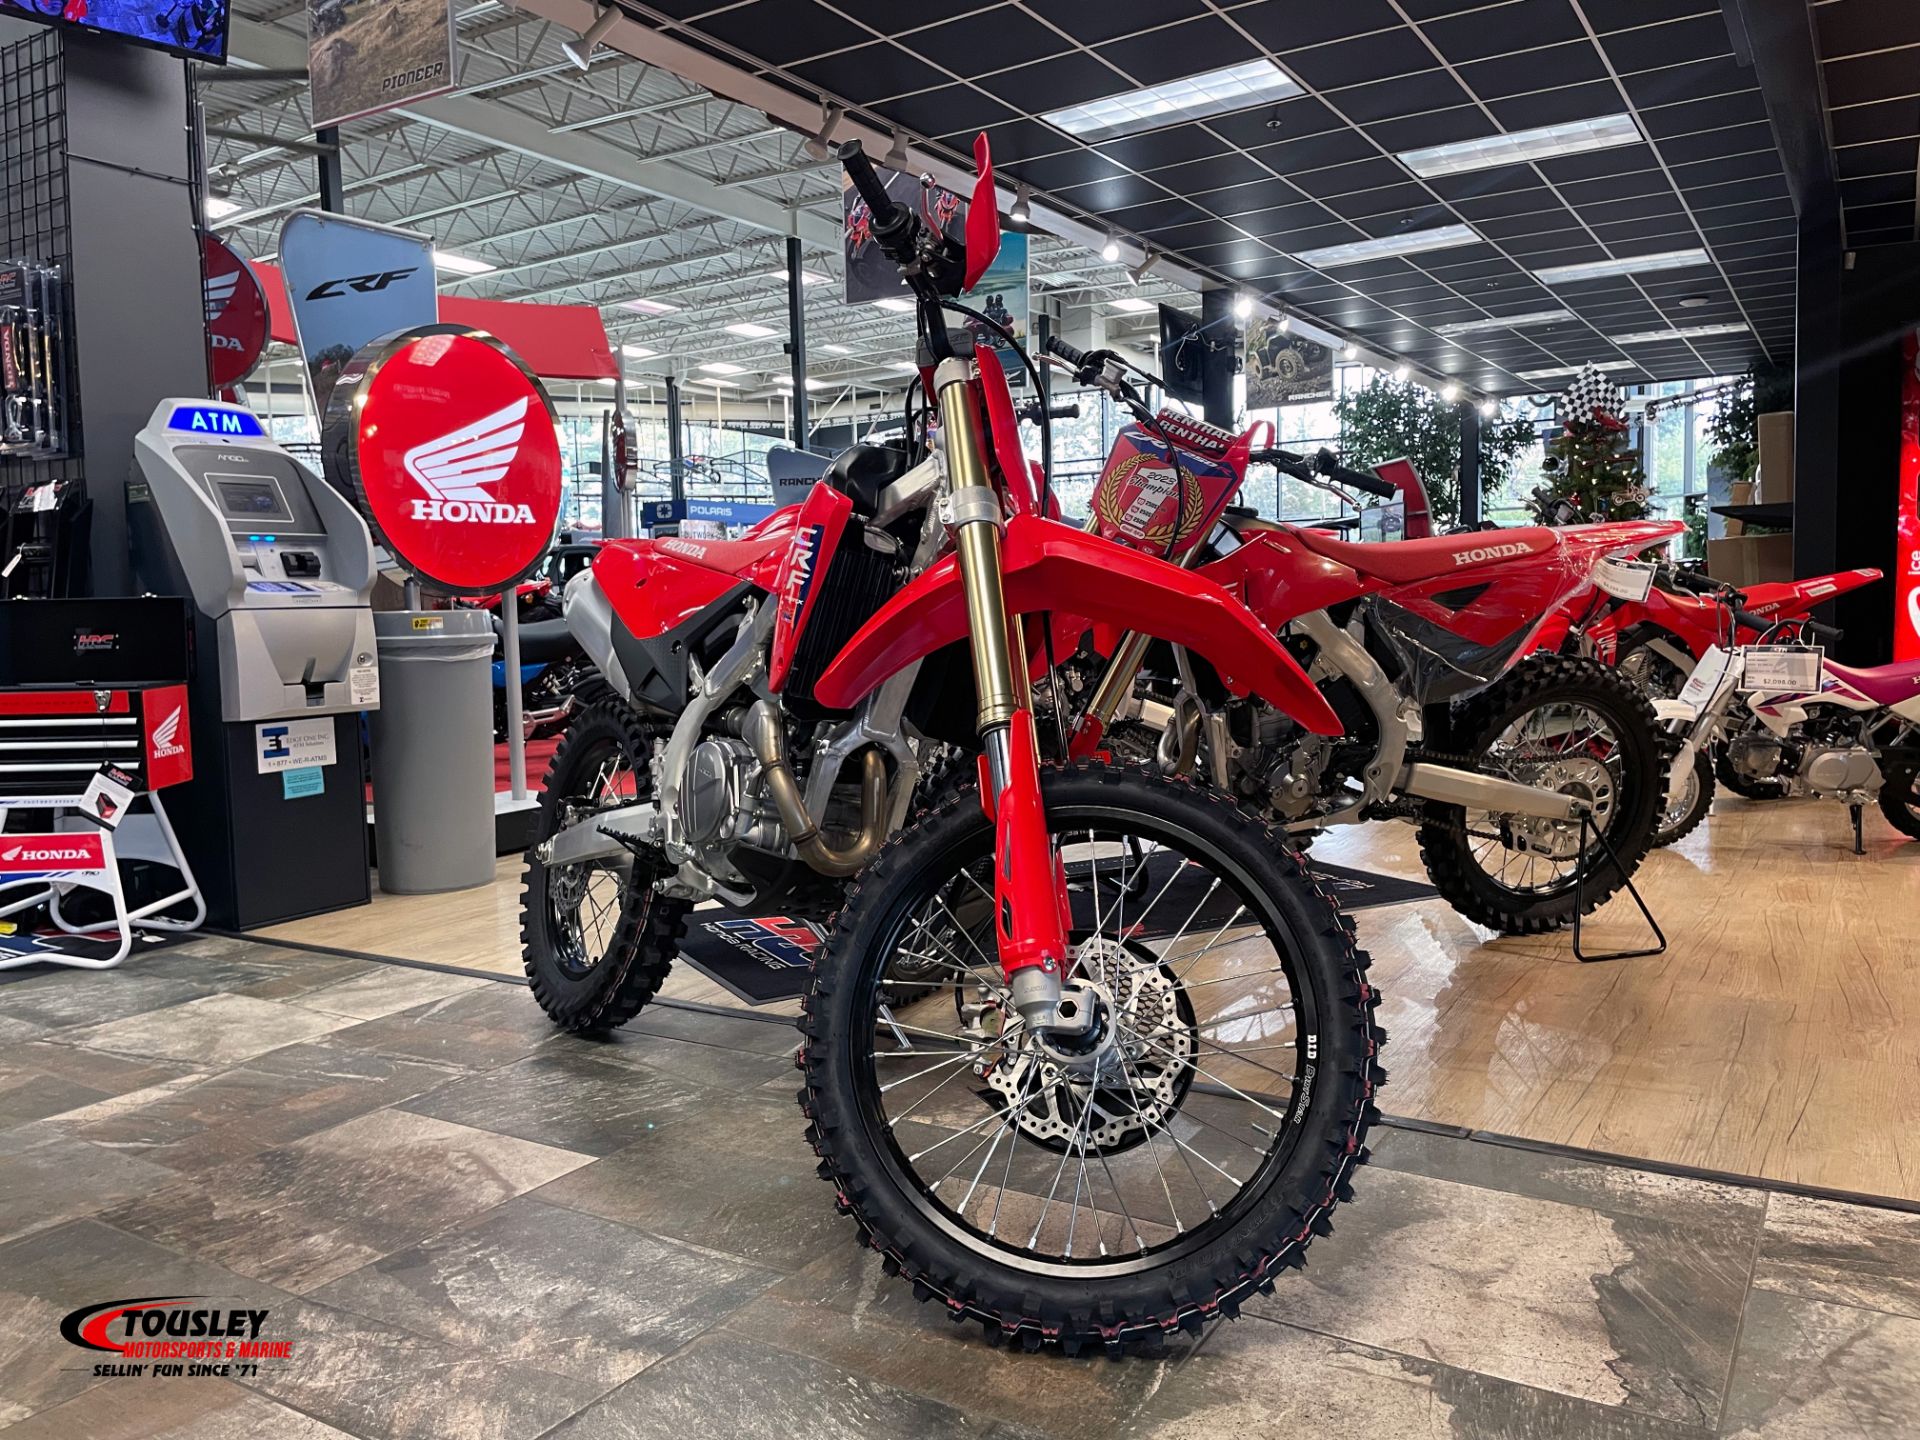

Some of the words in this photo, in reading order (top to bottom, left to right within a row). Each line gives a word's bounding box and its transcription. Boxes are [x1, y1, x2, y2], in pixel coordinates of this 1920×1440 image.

[382, 62, 443, 92] PIONEER
[305, 267, 419, 301] CRF
[1288, 391, 1331, 401] RANCHER
[191, 411, 242, 433] ATM
[1164, 408, 1231, 442] RENTHAL
[1160, 420, 1225, 449] RENTHA
[779, 477, 823, 487] RANCH
[1146, 471, 1177, 485] 2023
[411, 500, 536, 524] HONDA
[689, 505, 733, 517] POLARIS
[661, 539, 708, 560] HONDA
[786, 526, 818, 590] CRF
[1452, 542, 1535, 566] HONDA
[1749, 602, 1781, 616] ONDA
[153, 744, 185, 759] HONDA
[21, 849, 92, 861] HONDA
[735, 943, 787, 971] RACING
